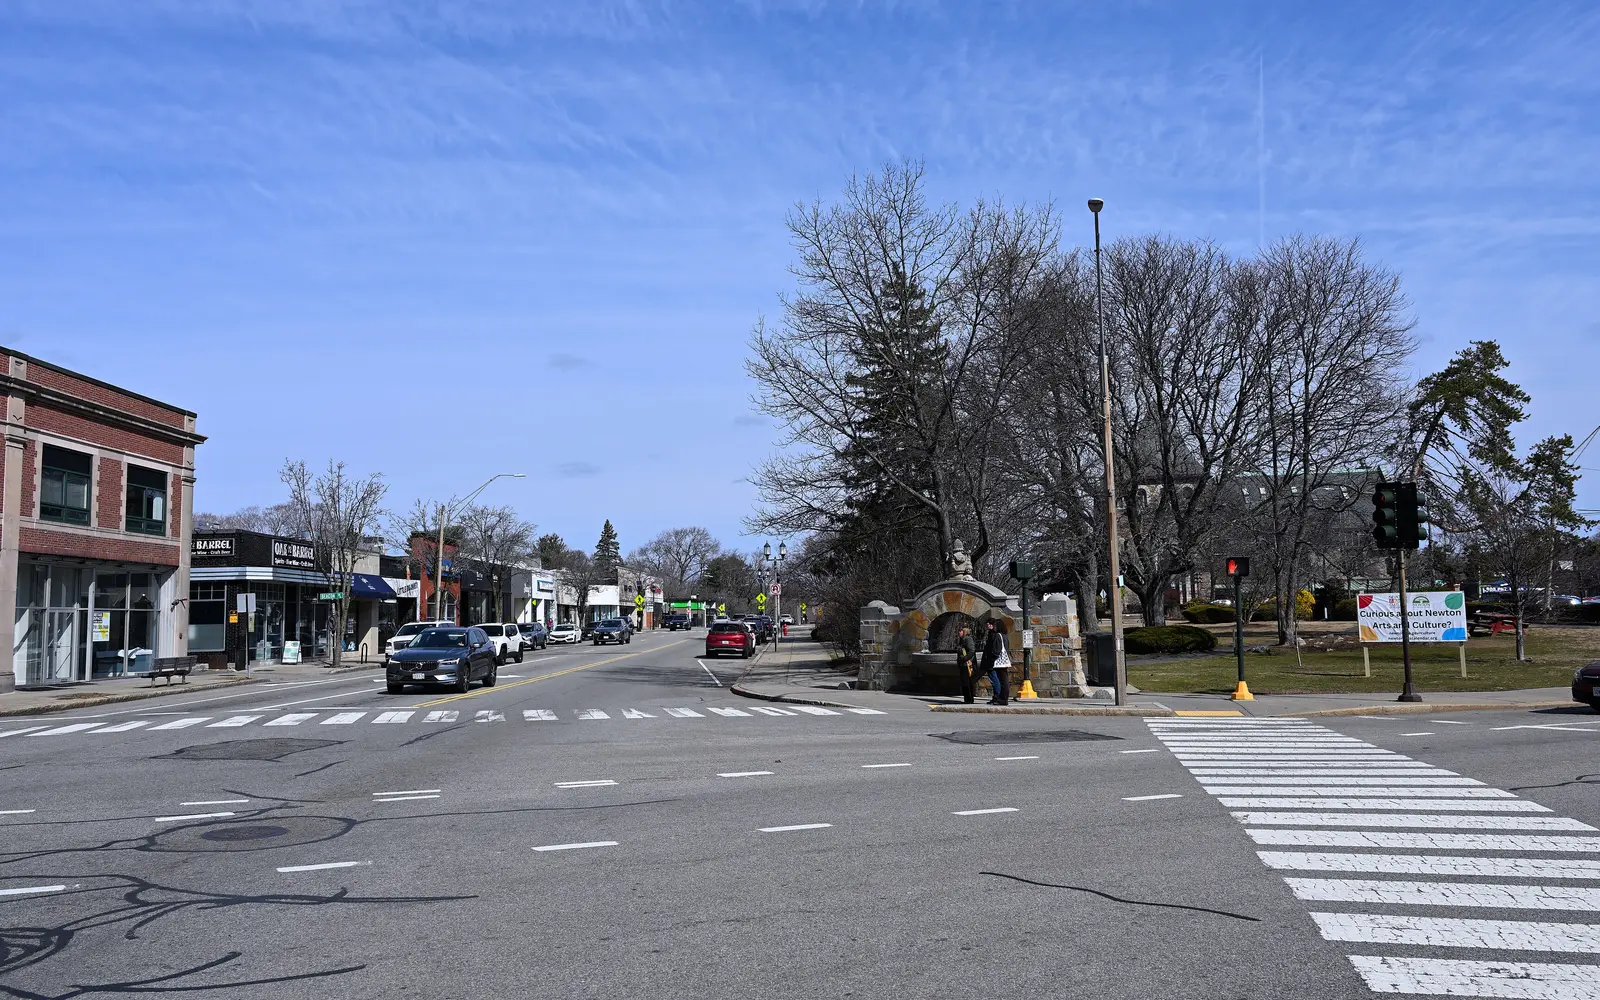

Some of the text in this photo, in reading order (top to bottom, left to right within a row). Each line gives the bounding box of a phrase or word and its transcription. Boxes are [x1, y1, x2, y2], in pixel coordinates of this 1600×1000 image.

[196, 540, 231, 549] BARREL
[274, 542, 287, 556] OAK
[292, 544, 314, 560] BARREL
[1425, 609, 1462, 617] Newton
[1412, 620, 1452, 629] Culture?
